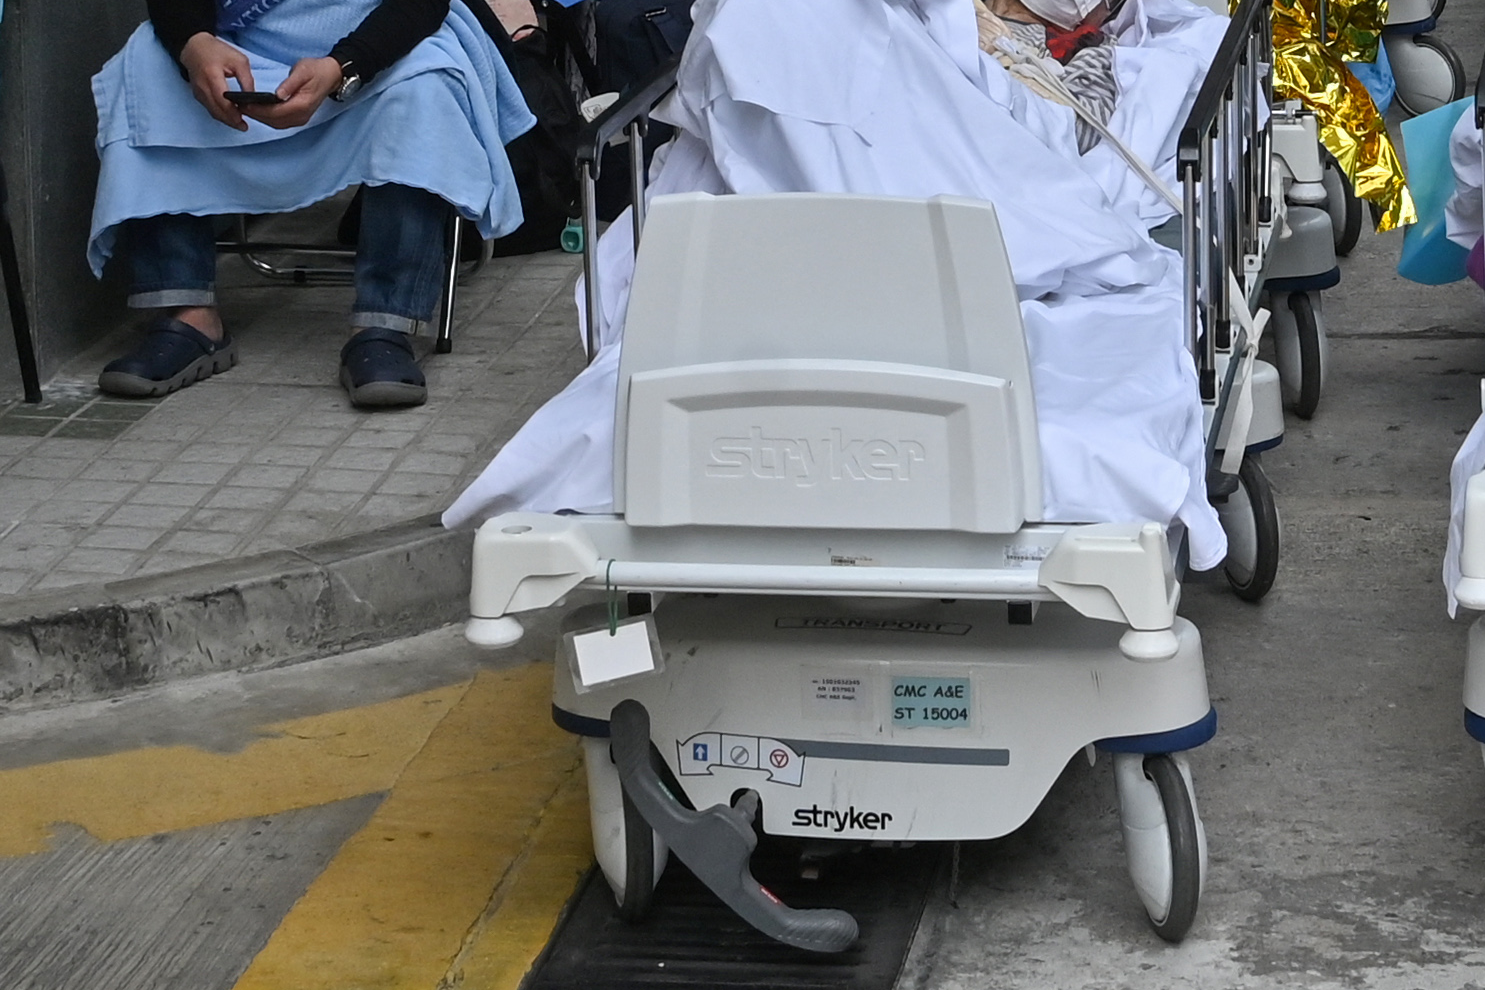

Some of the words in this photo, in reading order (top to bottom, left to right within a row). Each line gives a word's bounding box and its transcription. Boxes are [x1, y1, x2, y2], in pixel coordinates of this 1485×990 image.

[705, 426, 925, 487] stryker
[802, 618, 945, 631] TRANSPORT
[894, 685, 927, 698] CMC
[933, 685, 965, 699] A&E
[894, 708, 916, 720] ST
[922, 708, 968, 721] 15004
[792, 804, 893, 832] stryker
